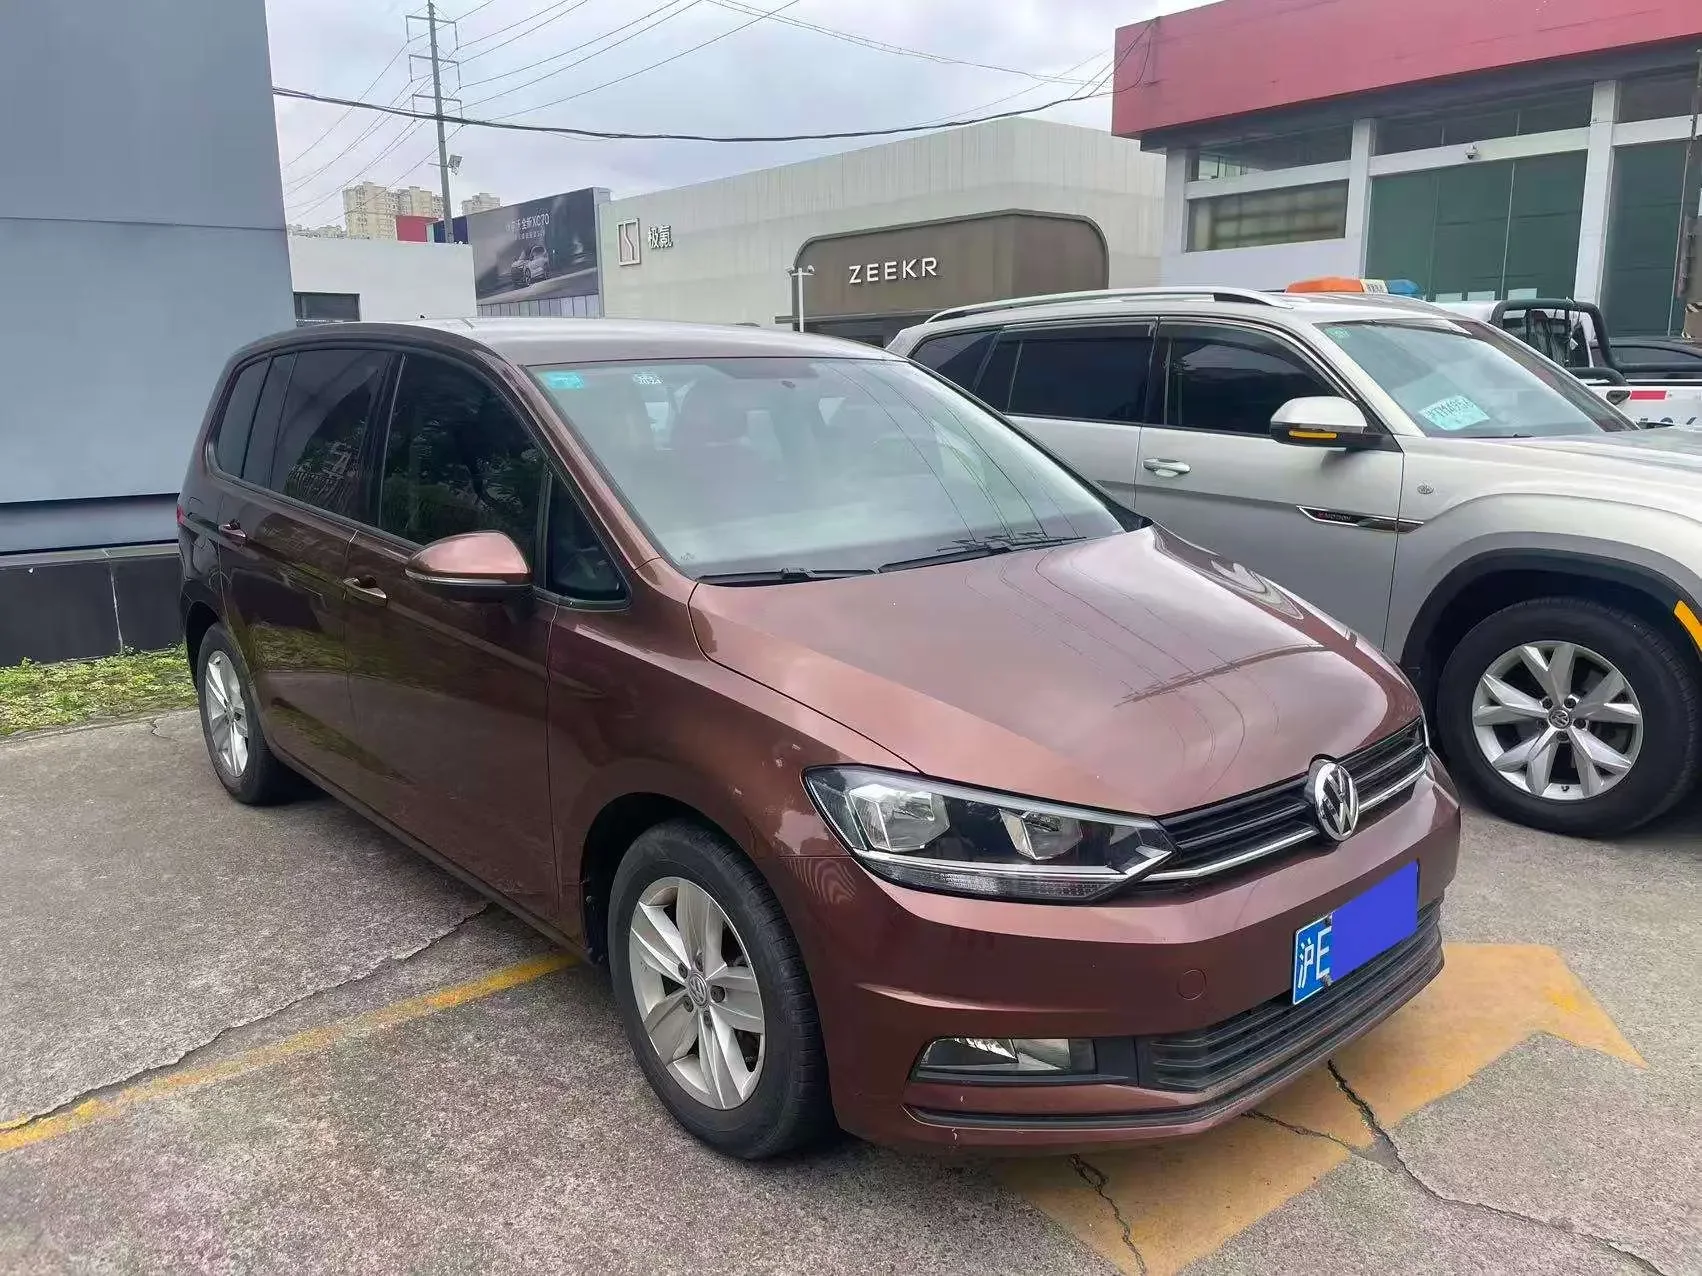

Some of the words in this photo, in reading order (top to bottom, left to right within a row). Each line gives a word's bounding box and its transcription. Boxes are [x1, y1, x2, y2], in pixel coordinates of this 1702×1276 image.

[648, 225, 673, 249] 极氪
[848, 257, 938, 284] ZEEKR
[1297, 926, 1332, 989] 沪E
